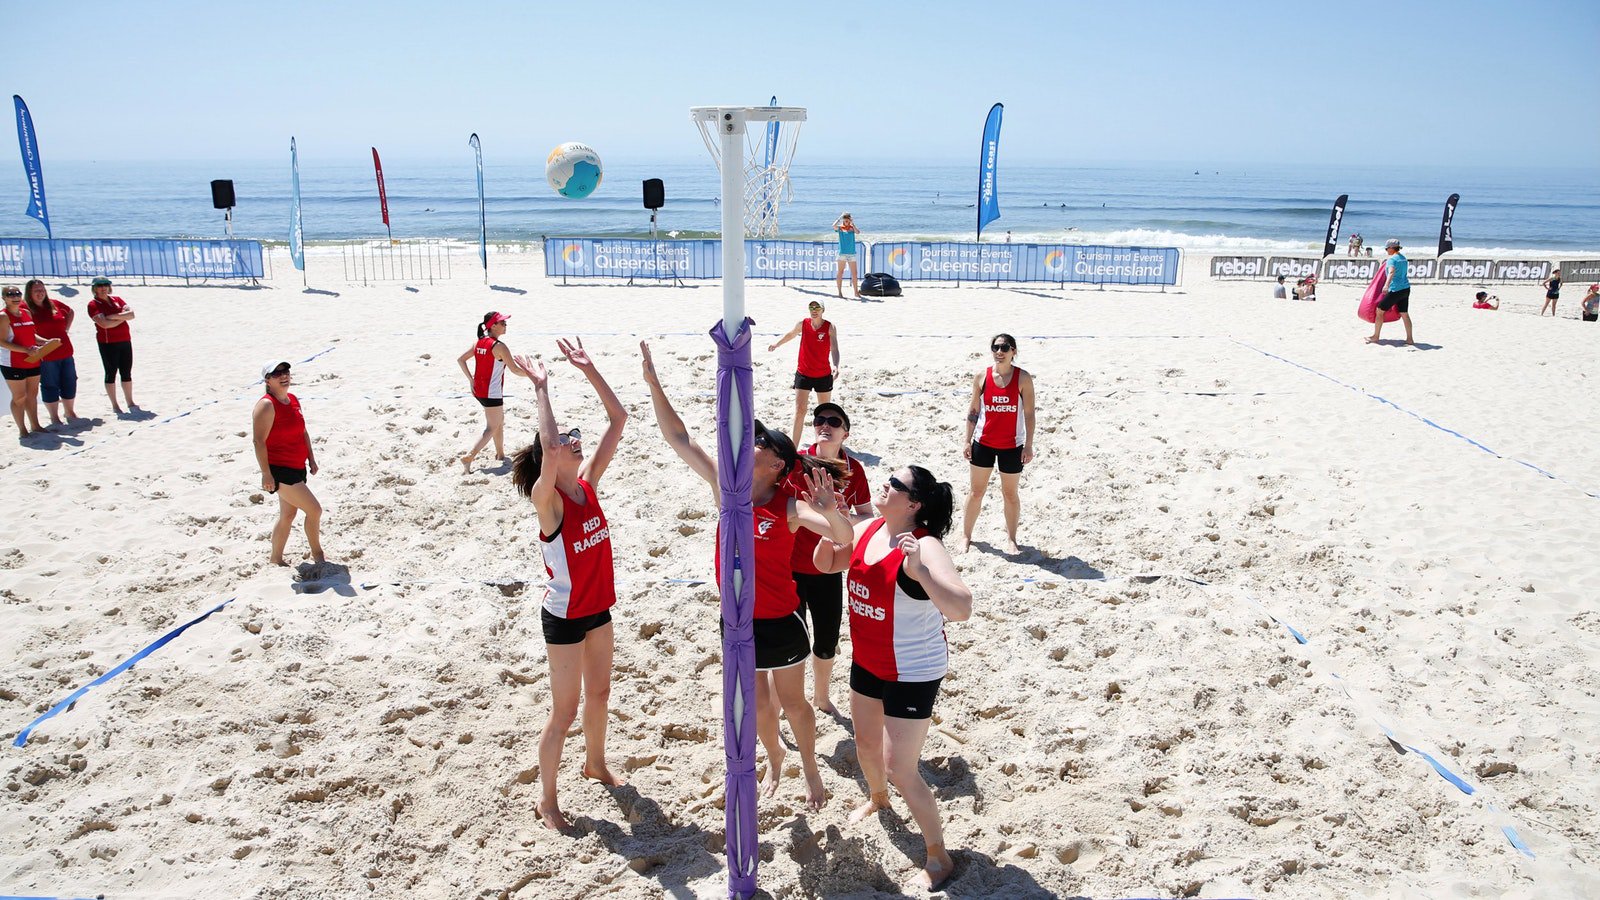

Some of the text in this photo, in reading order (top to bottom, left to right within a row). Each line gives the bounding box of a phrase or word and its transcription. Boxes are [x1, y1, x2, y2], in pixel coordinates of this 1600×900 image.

[983, 140, 996, 197] Gold Coast
[1329, 206, 1343, 245] rebel
[95, 245, 129, 263] LIVE!
[203, 246, 238, 265] LIVE!
[593, 244, 689, 256] Tourism and Events
[755, 246, 793, 256] Tourism
[795, 246, 815, 256] and
[920, 248, 1013, 259] Tourism and Events
[1076, 251, 1164, 262] Tourism and Events
[80, 261, 125, 273] Queensland
[188, 262, 234, 273] Queensland
[594, 255, 689, 271] Queensland
[919, 258, 1012, 273] Queensland
[1075, 261, 1163, 277] Queensland
[1215, 258, 1262, 275] rebel
[1271, 258, 1319, 276] rebel
[1328, 260, 1375, 278] rebel
[1407, 261, 1433, 278] bel
[1443, 261, 1491, 278] rebel
[1499, 262, 1547, 279] rebel
[582, 516, 601, 534] RED
[573, 526, 609, 554] RAGERS
[849, 579, 870, 600] RED
